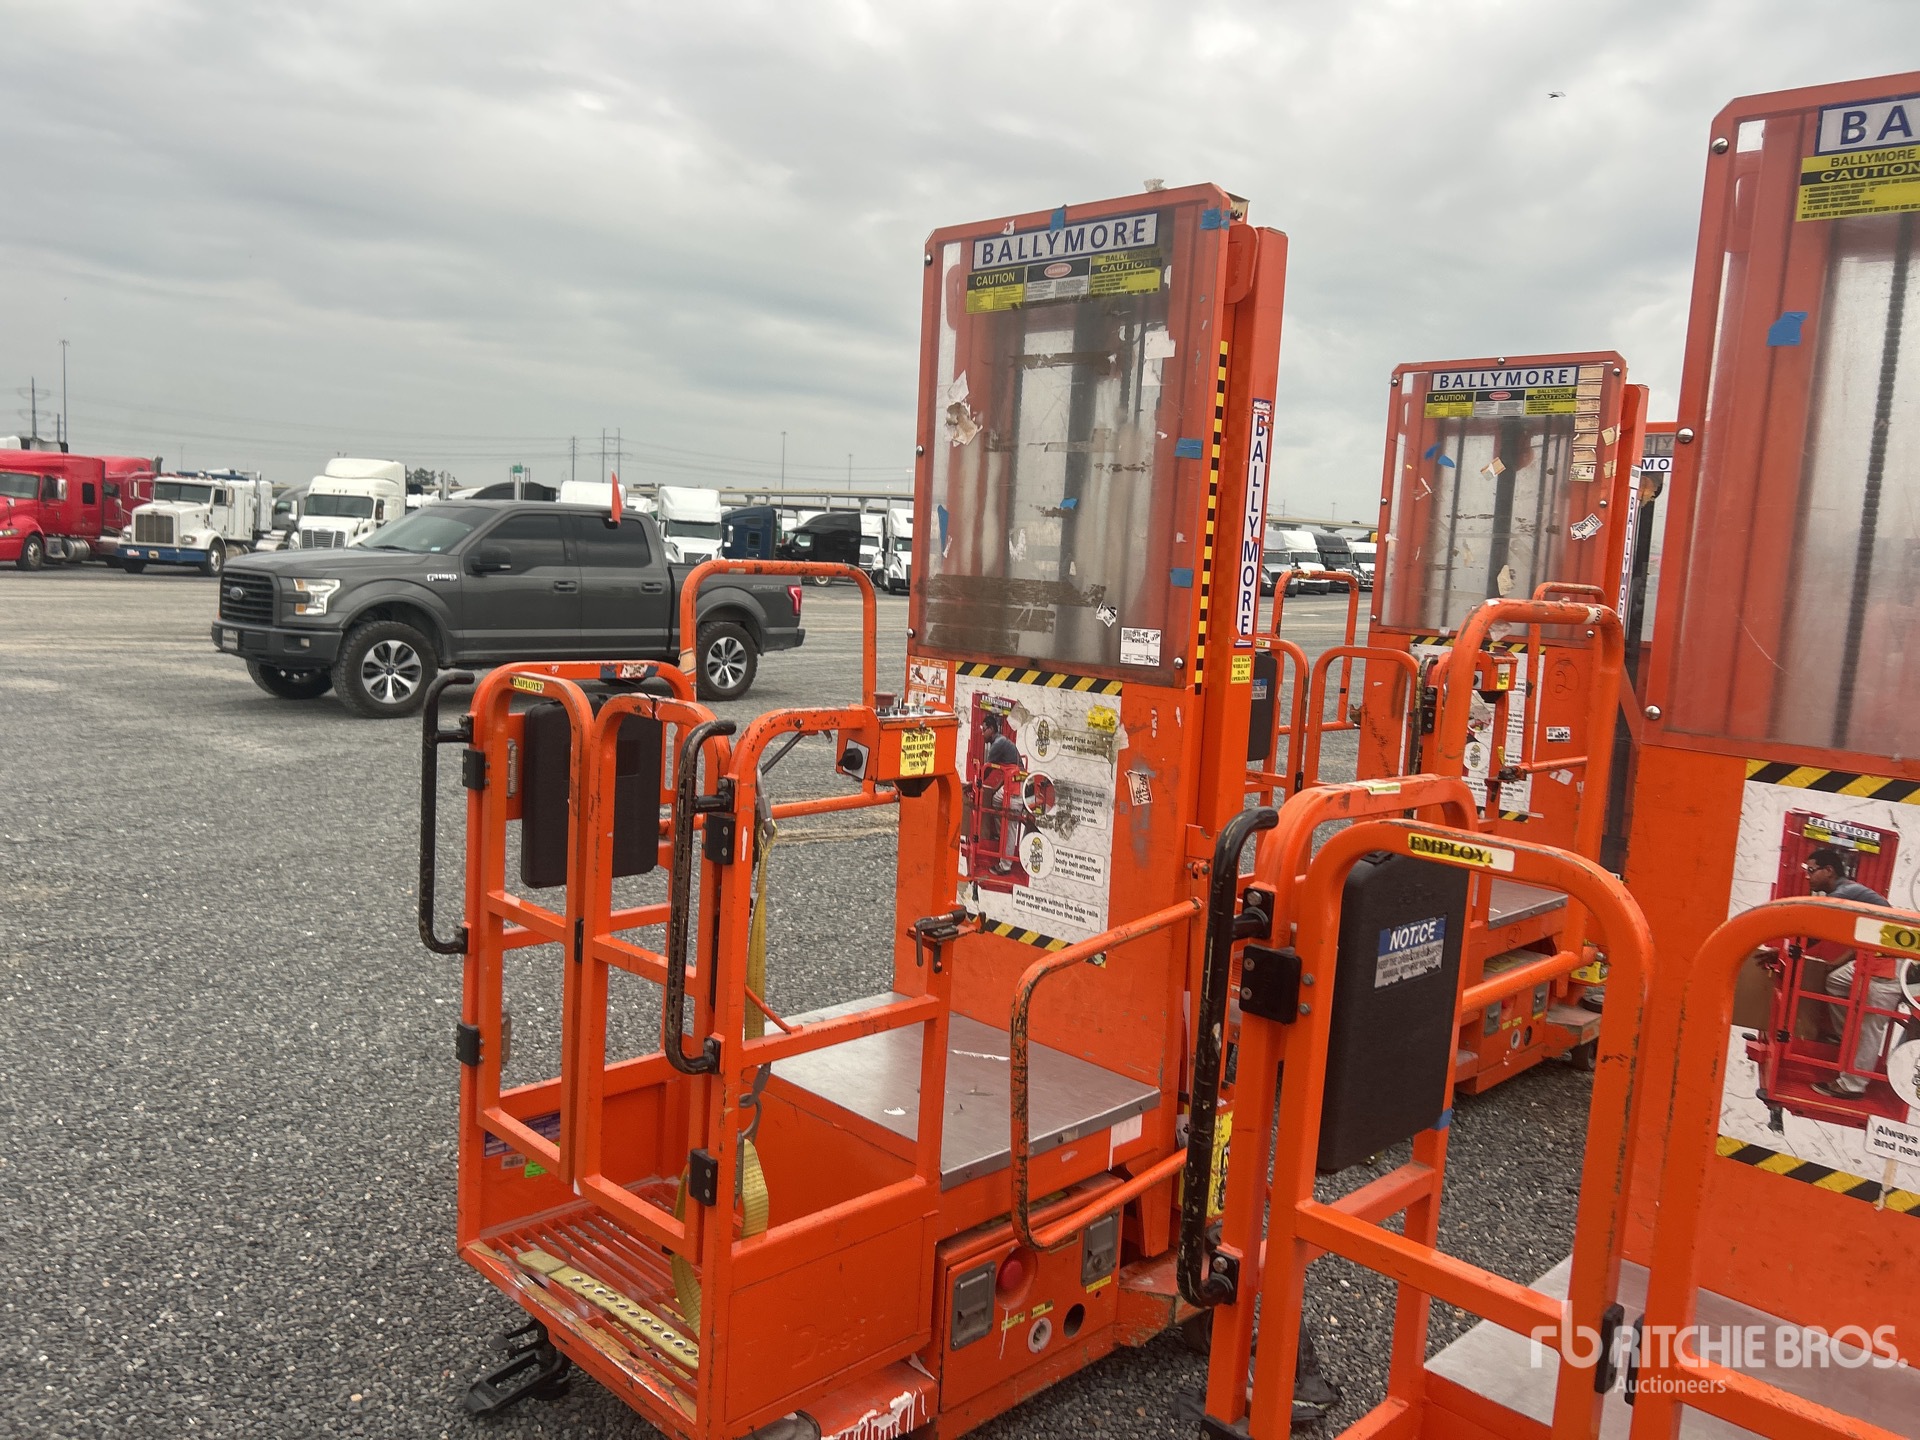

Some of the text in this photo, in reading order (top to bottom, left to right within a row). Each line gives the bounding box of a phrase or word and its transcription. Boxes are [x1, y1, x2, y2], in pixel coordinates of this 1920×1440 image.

[1831, 149, 1916, 168] BALLYMORE
[1820, 163, 1920, 183] CAUTION
[982, 218, 1147, 266] BALLYMORE
[976, 272, 1015, 287] CAUTION
[1439, 369, 1568, 389] BALLYMORE
[1433, 394, 1467, 402] CAUTION
[1241, 415, 1269, 635] BALLYMORE
[1618, 496, 1636, 622] BALLYMOR
[1082, 789, 1094, 798] body
[1096, 791, 1104, 799] belt
[1083, 807, 1095, 815] hook
[1812, 818, 1877, 840] BALLYMORE
[1056, 849, 1073, 859] Always
[1410, 836, 1494, 864] EMPLOY
[1056, 858, 1067, 866] body
[1079, 864, 1101, 874] attached
[1016, 890, 1034, 900] Always
[1048, 899, 1064, 908] within
[1065, 901, 1074, 911] the
[1074, 906, 1086, 915] side
[1087, 910, 1099, 918] rails
[1026, 902, 1040, 910] never
[1041, 906, 1055, 915] stand
[1074, 915, 1086, 923] rails.
[1389, 921, 1437, 951] NOTICE
[1876, 1124, 1918, 1144] Always
[1873, 1138, 1920, 1157] and nev
